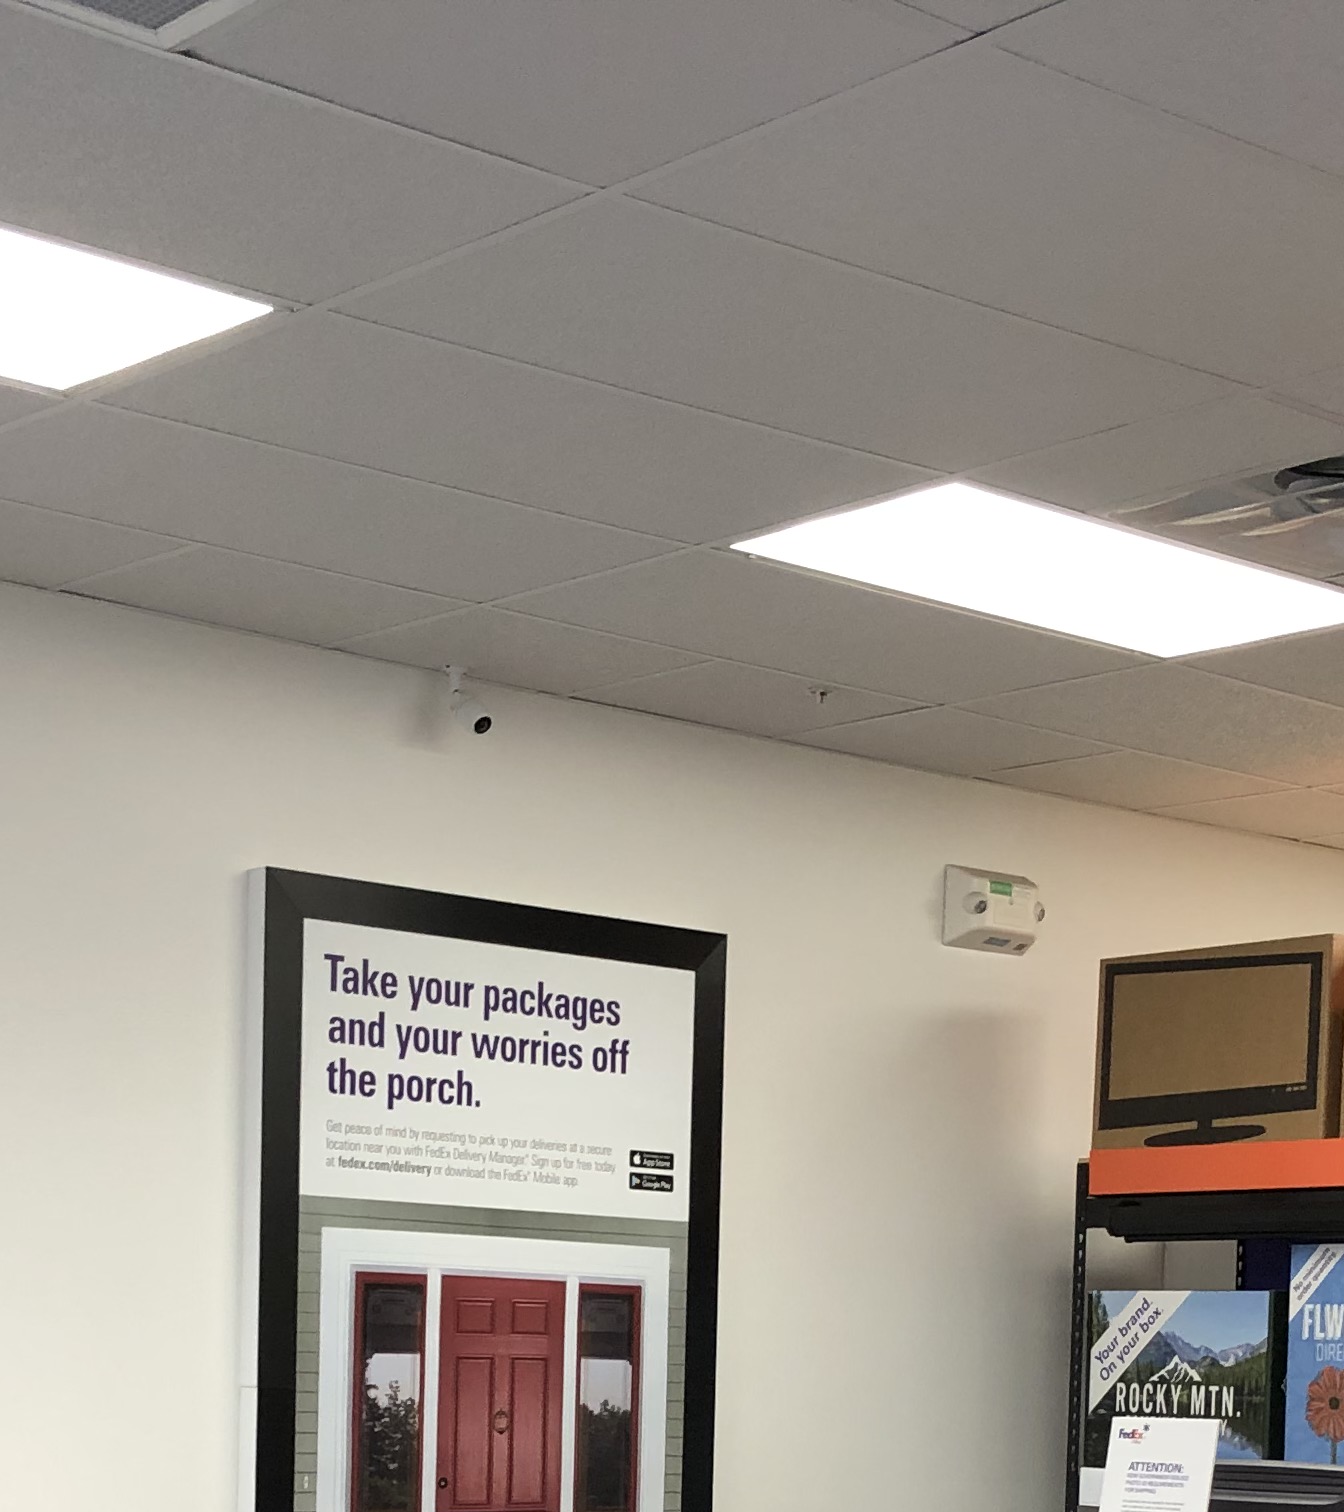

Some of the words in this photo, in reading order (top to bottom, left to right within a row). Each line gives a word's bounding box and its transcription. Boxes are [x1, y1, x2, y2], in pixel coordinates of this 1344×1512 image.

[323, 953, 399, 1000] Take
[408, 972, 475, 1012] your
[483, 981, 622, 1031] packages
[327, 1011, 386, 1049] and
[395, 1022, 463, 1060] your
[470, 1030, 583, 1070] worries
[591, 1037, 630, 1075] off
[326, 1057, 376, 1098] the
[386, 1069, 481, 1110] porch.
[325, 1119, 342, 1134] Get
[385, 1125, 407, 1138] mind
[409, 1127, 419, 1142] by
[421, 1129, 466, 1146] requesting
[478, 1133, 496, 1148] pick
[510, 1138, 528, 1150] your
[325, 1137, 361, 1152] location
[363, 1142, 384, 1154] near
[385, 1143, 402, 1157] you
[403, 1143, 423, 1157] with
[424, 1145, 452, 1159] FedEx
[452, 1146, 487, 1164] Delivery
[531, 1154, 550, 1170] Sign
[337, 1155, 432, 1178] fedex.com/delivery
[444, 1163, 486, 1180] download
[532, 1170, 561, 1186] Mobile
[1094, 1335, 1119, 1365] Your
[1117, 1297, 1154, 1337] brand.
[1099, 1360, 1118, 1382] On
[1116, 1332, 1141, 1364] your
[1138, 1306, 1165, 1334] box.
[1115, 1382, 1182, 1415] ROCKY
[1190, 1384, 1241, 1418] MTN.
[1118, 1428, 1145, 1440] FedEx
[1127, 1461, 1185, 1474] ATTENTION:
